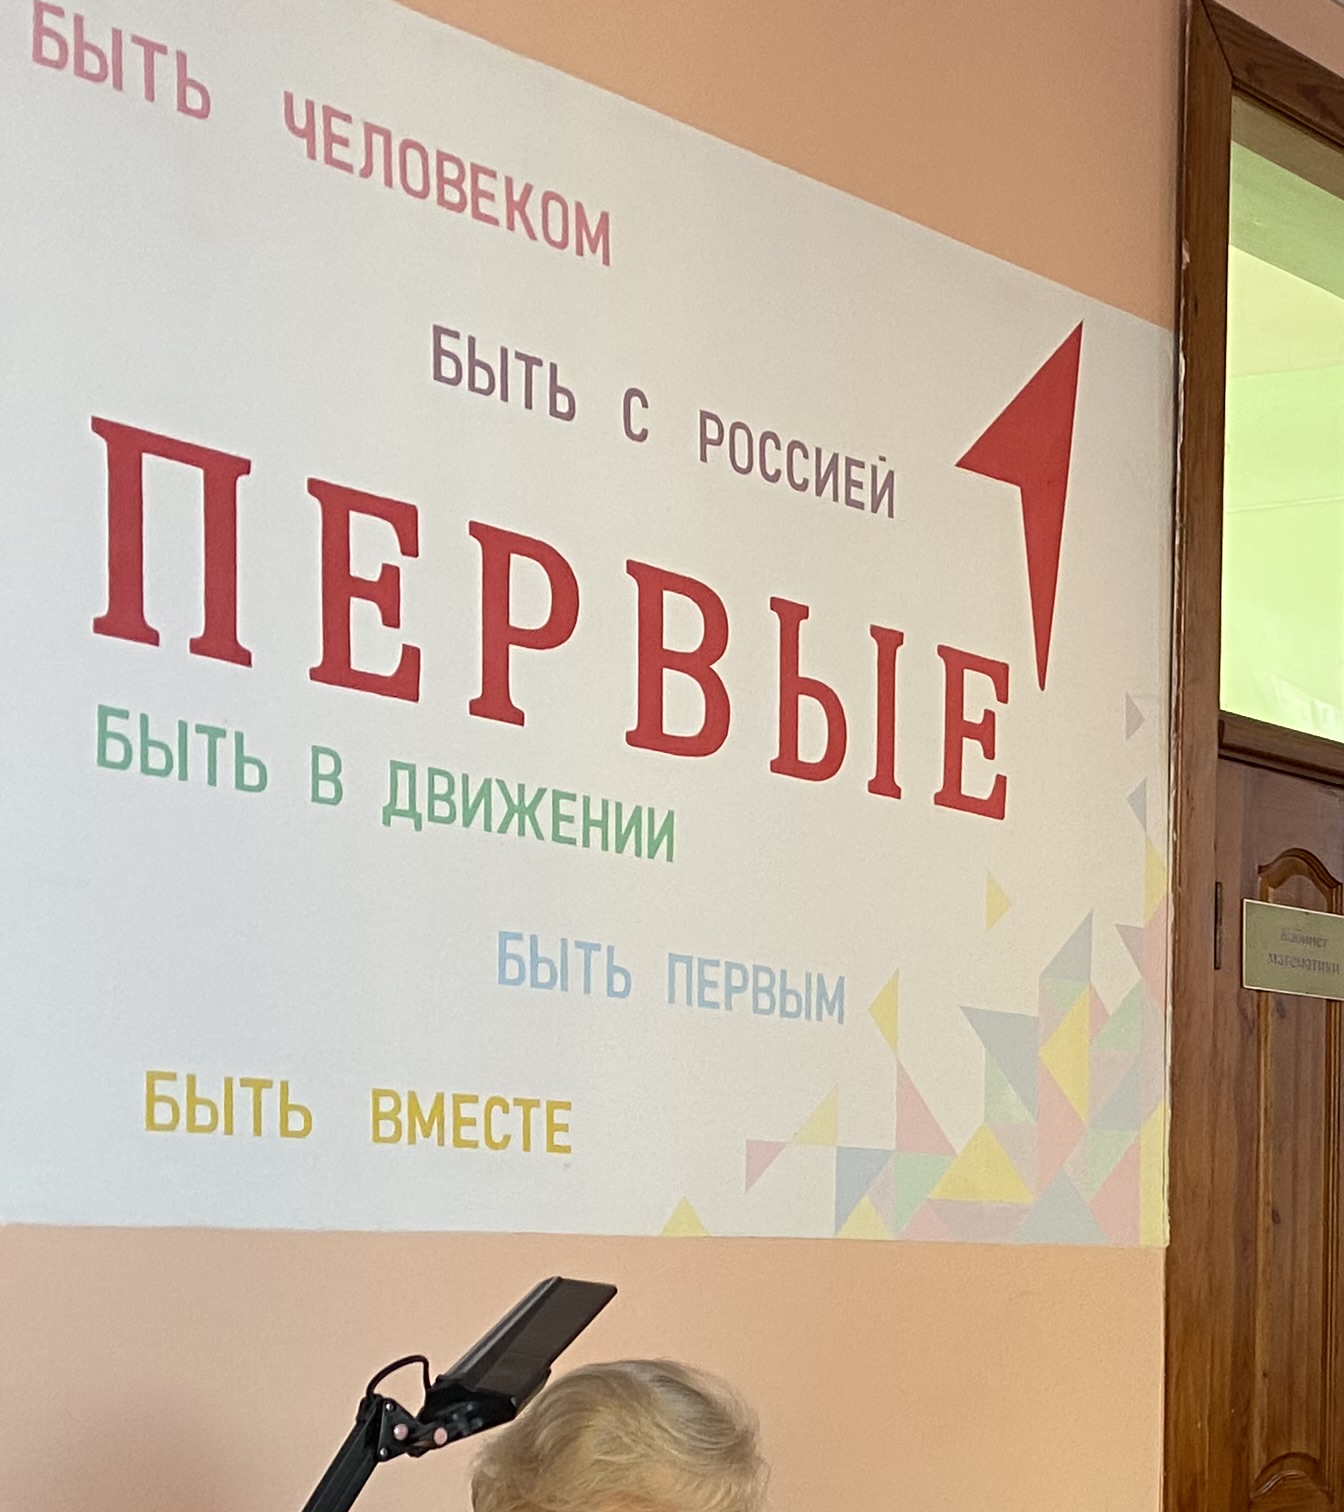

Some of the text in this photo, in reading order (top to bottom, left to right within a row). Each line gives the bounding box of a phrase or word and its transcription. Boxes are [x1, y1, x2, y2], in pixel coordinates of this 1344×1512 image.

[32, 0, 610, 267] БЫТЬ ЧЕЛОВЕКОМ
[432, 324, 895, 518] БЫТЬ С РОССИЕЙ
[90, 416, 1010, 820] ПЕРВЫЕ
[96, 704, 676, 863] БЫТЬ В ДВИЖЕНИИ
[498, 931, 846, 1024] БЫТЬ ПЕРВЫМ
[144, 1070, 572, 1154] БЫТЬ ВМЕСТЕ
